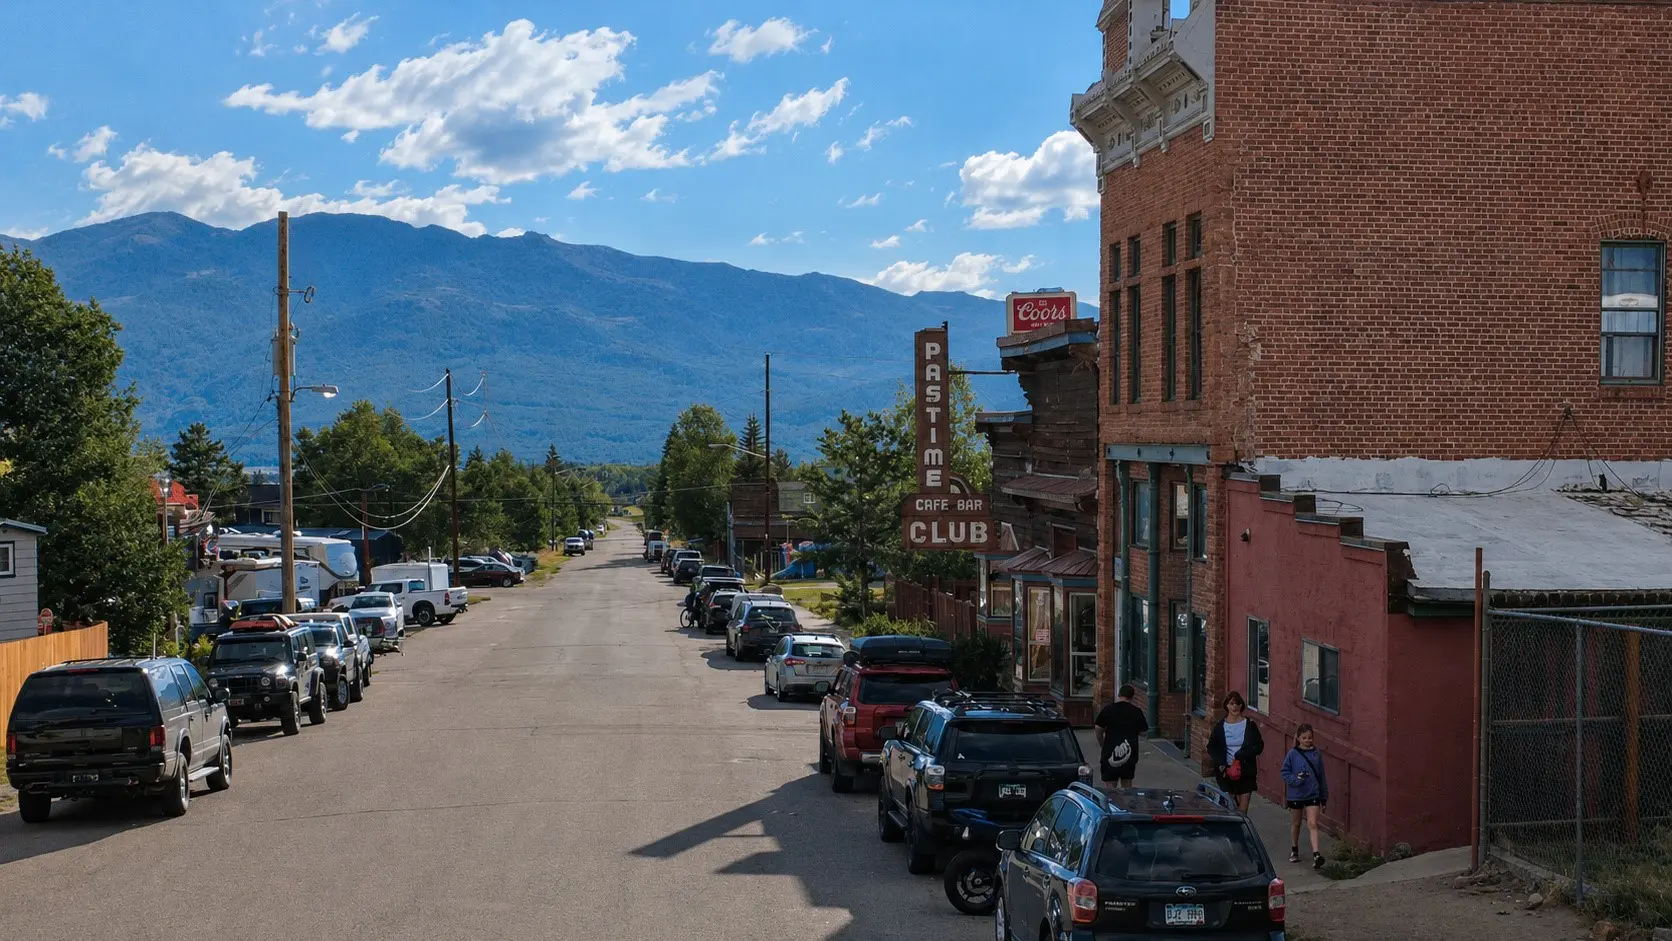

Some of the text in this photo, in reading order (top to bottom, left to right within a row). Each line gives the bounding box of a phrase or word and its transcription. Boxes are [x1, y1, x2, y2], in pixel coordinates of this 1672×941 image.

[1017, 302, 1067, 321] Coors
[924, 342, 944, 487] PASTIME
[915, 499, 983, 511] CAFE BAR
[909, 521, 988, 544] CLUB
